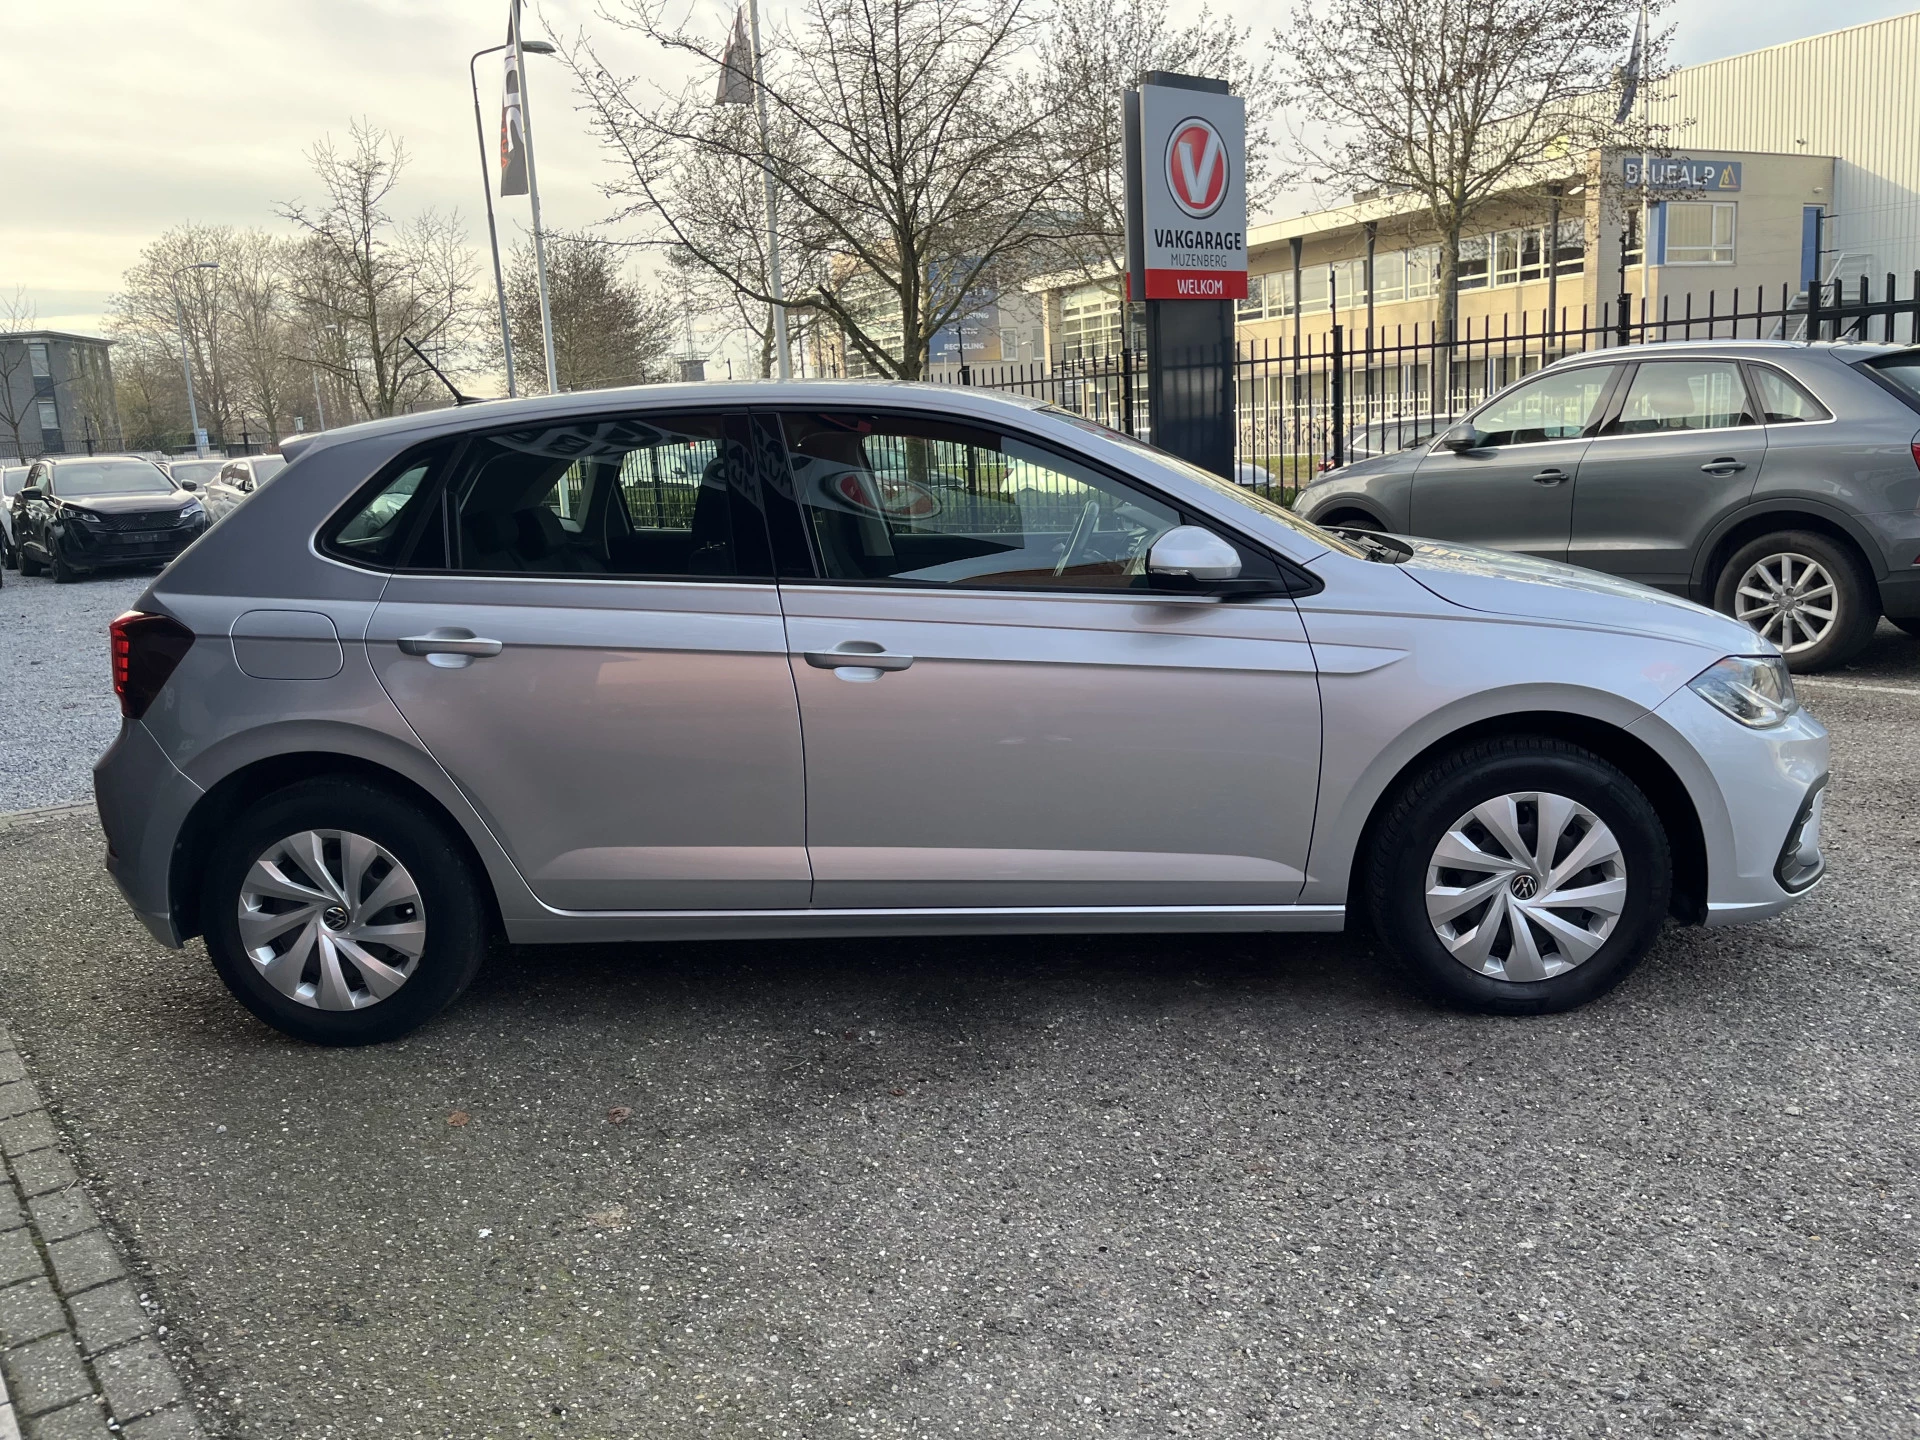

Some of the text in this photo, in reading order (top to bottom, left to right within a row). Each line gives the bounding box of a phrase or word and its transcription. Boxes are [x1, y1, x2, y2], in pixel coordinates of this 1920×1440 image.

[1178, 131, 1220, 204] V
[1154, 228, 1242, 251] VAKGARAGE
[1170, 253, 1228, 268] MUZENBERG
[1176, 279, 1224, 295] WELKOM
